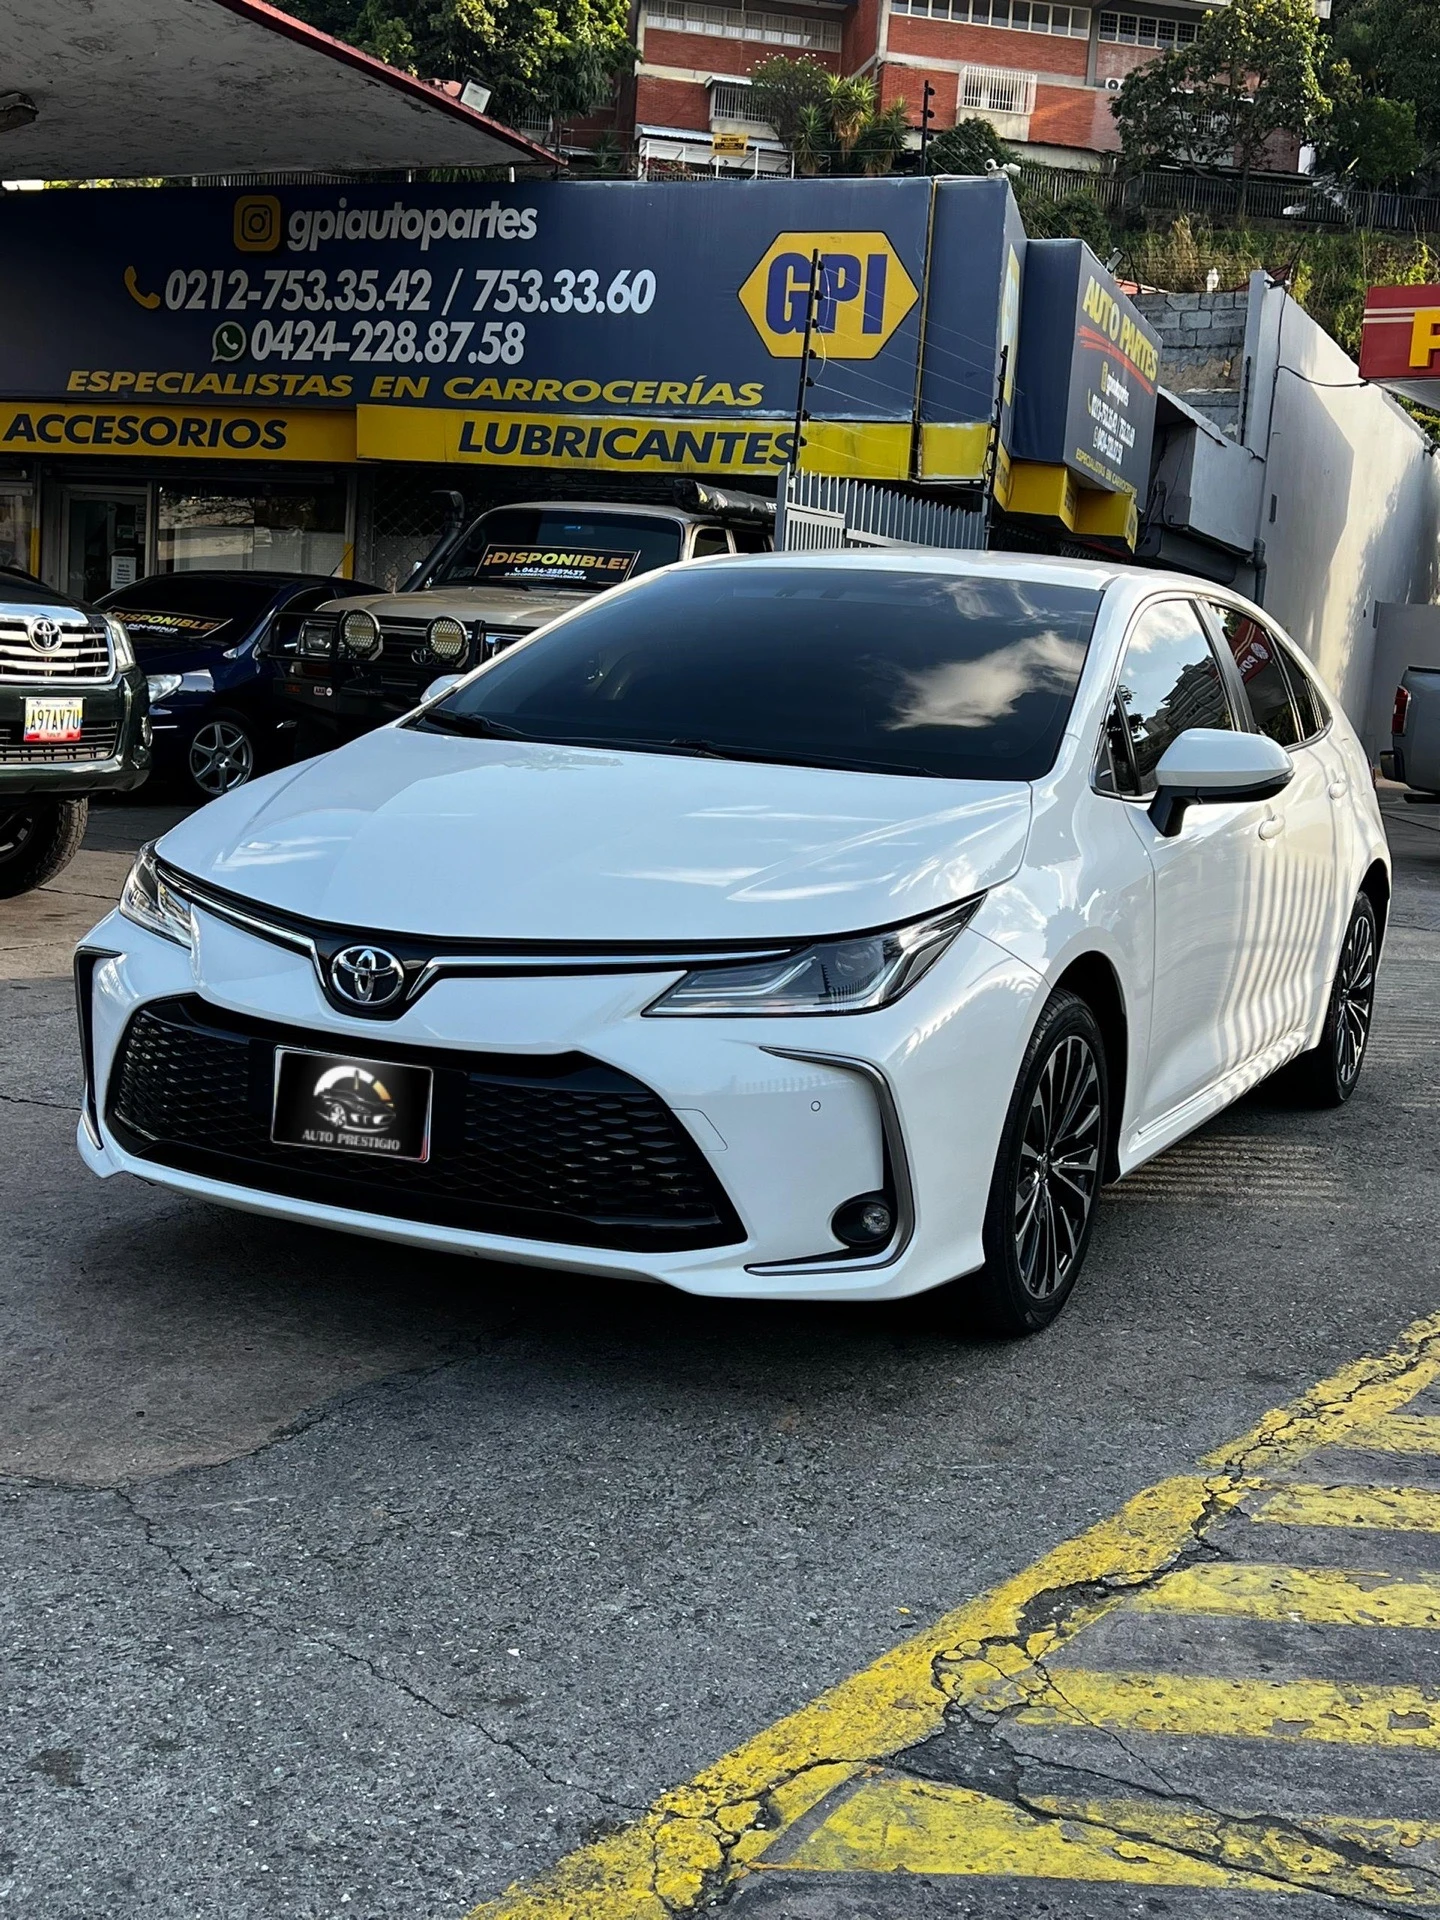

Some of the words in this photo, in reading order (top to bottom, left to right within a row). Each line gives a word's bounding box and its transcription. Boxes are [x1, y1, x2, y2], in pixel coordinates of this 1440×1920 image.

[287, 198, 537, 252] gpiautopartes
[165, 268, 432, 311] 0212-753.35.42
[441, 268, 464, 316] /
[472, 269, 656, 314] 753.33.60
[765, 252, 888, 335] GPI
[250, 319, 526, 366] 0424-228.87.58
[1082, 275, 1121, 342] AUTO
[1119, 313, 1159, 383] PARTES
[66, 370, 355, 398] ESPECIALISTAS
[370, 375, 428, 399] EN
[442, 375, 765, 407] CARROCERÍAS
[3, 413, 287, 450] ACCESORIOS
[458, 421, 798, 466] LUBRICANTES
[484, 551, 630, 570] ¡DISPONIBLE!
[30, 709, 80, 731] A97AV7U
